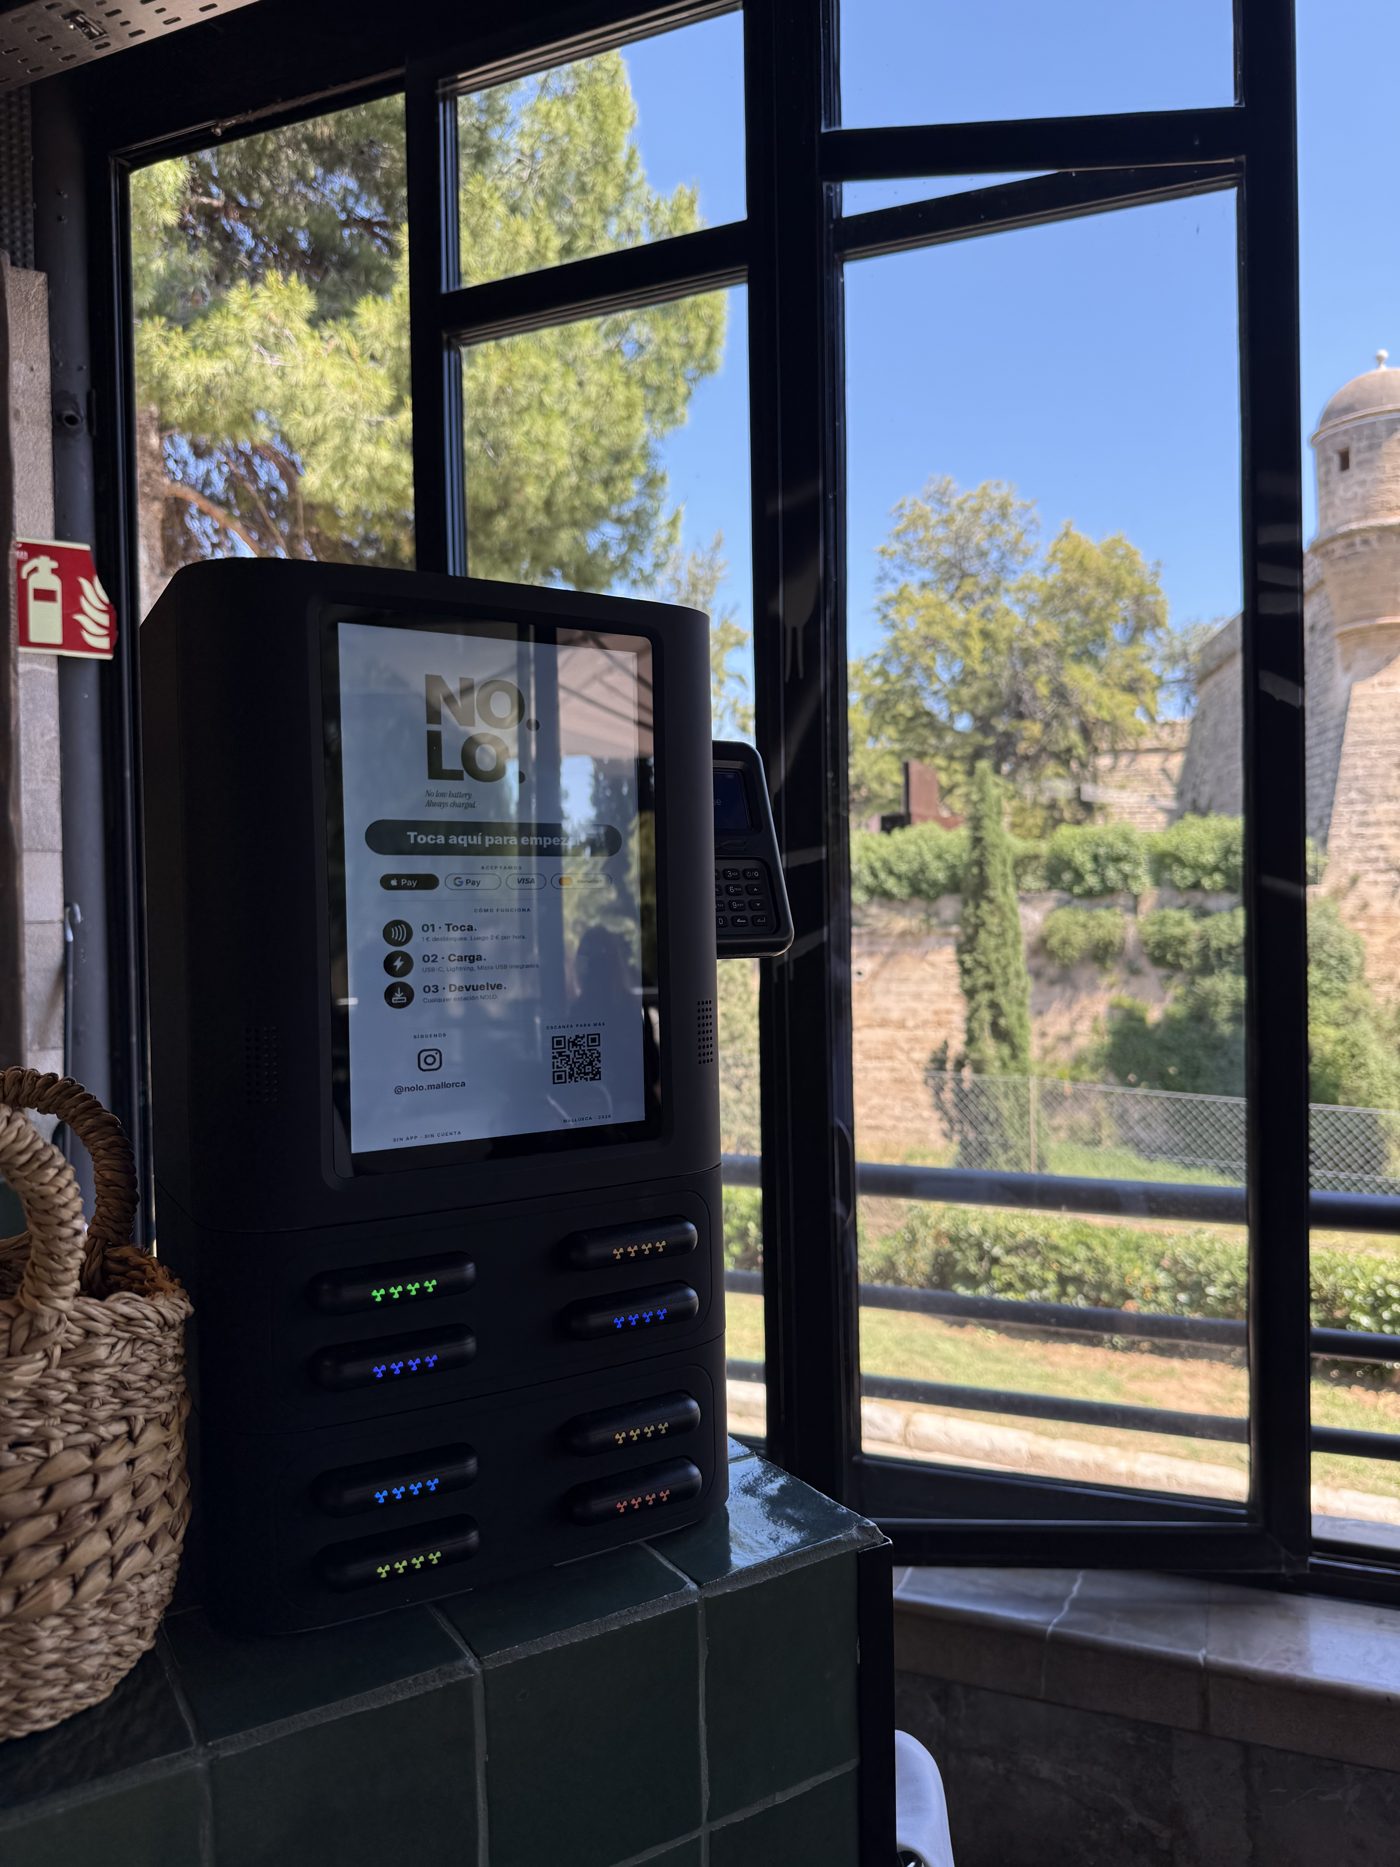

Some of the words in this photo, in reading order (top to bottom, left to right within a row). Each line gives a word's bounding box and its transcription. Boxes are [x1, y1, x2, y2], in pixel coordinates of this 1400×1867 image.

[425, 674, 540, 731] NO.
[427, 730, 525, 784] LO.
[407, 832, 445, 844] Toca
[449, 832, 482, 848] aquí
[485, 836, 518, 848] para
[521, 837, 580, 848] empezr
[400, 878, 418, 888] Pay
[465, 879, 481, 888] Pay
[517, 877, 536, 885] VISA
[421, 923, 435, 933] 01
[445, 923, 478, 932] Toca.
[422, 954, 438, 963] 02
[448, 953, 487, 964] Carga.
[422, 985, 440, 994] 03
[448, 982, 507, 993] Devuelve.
[394, 1081, 466, 1095] @nolo.mallorca
